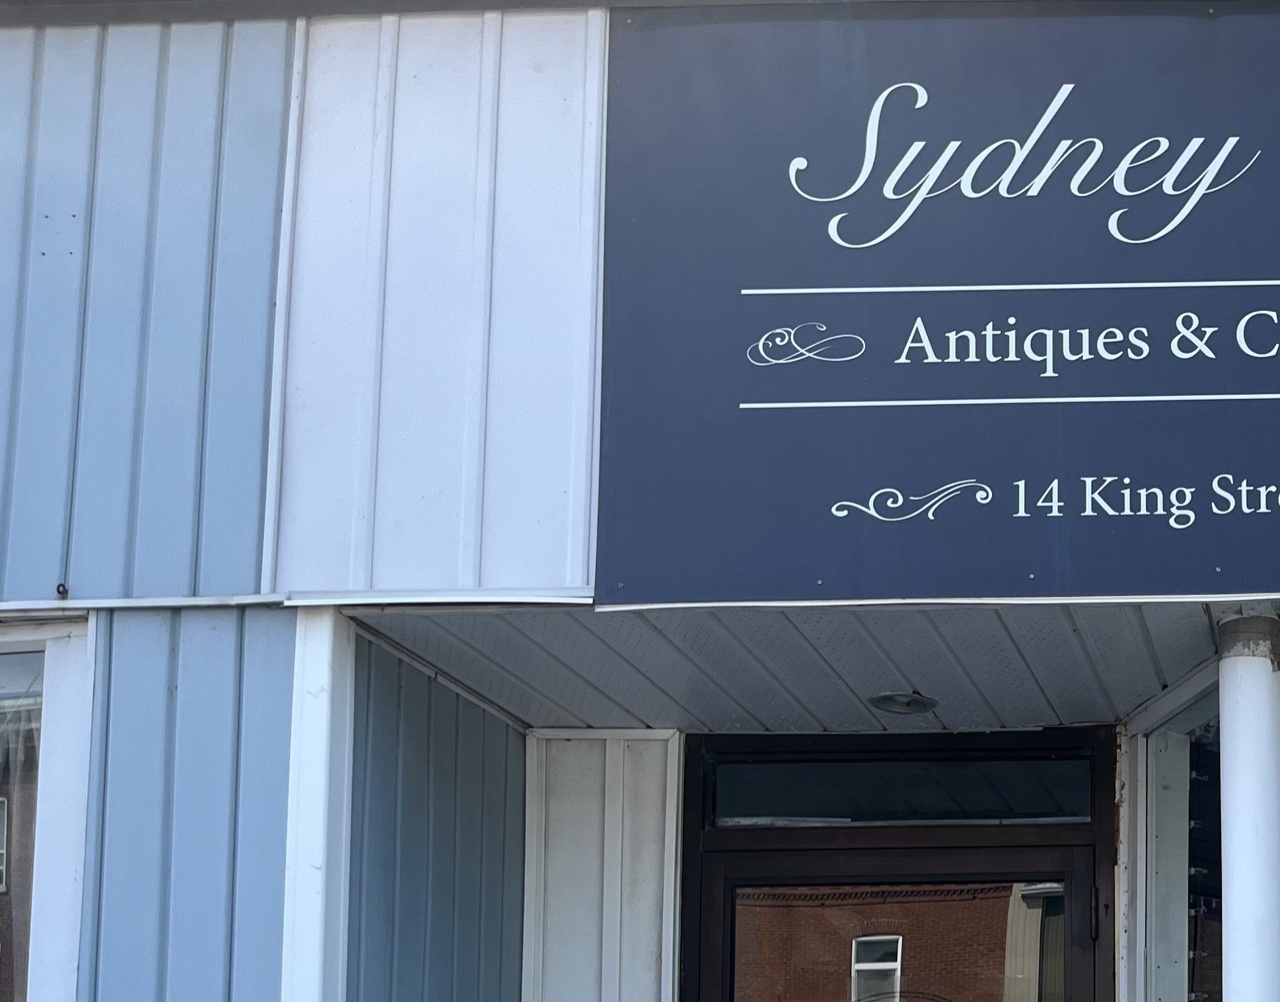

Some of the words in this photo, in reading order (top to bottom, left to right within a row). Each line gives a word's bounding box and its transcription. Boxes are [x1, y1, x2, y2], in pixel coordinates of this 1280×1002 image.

[788, 83, 1262, 248] Sydney
[895, 316, 1150, 376] Antiques
[1171, 312, 1219, 359] &
[1012, 478, 1065, 517] 14
[1081, 476, 1196, 528] King
